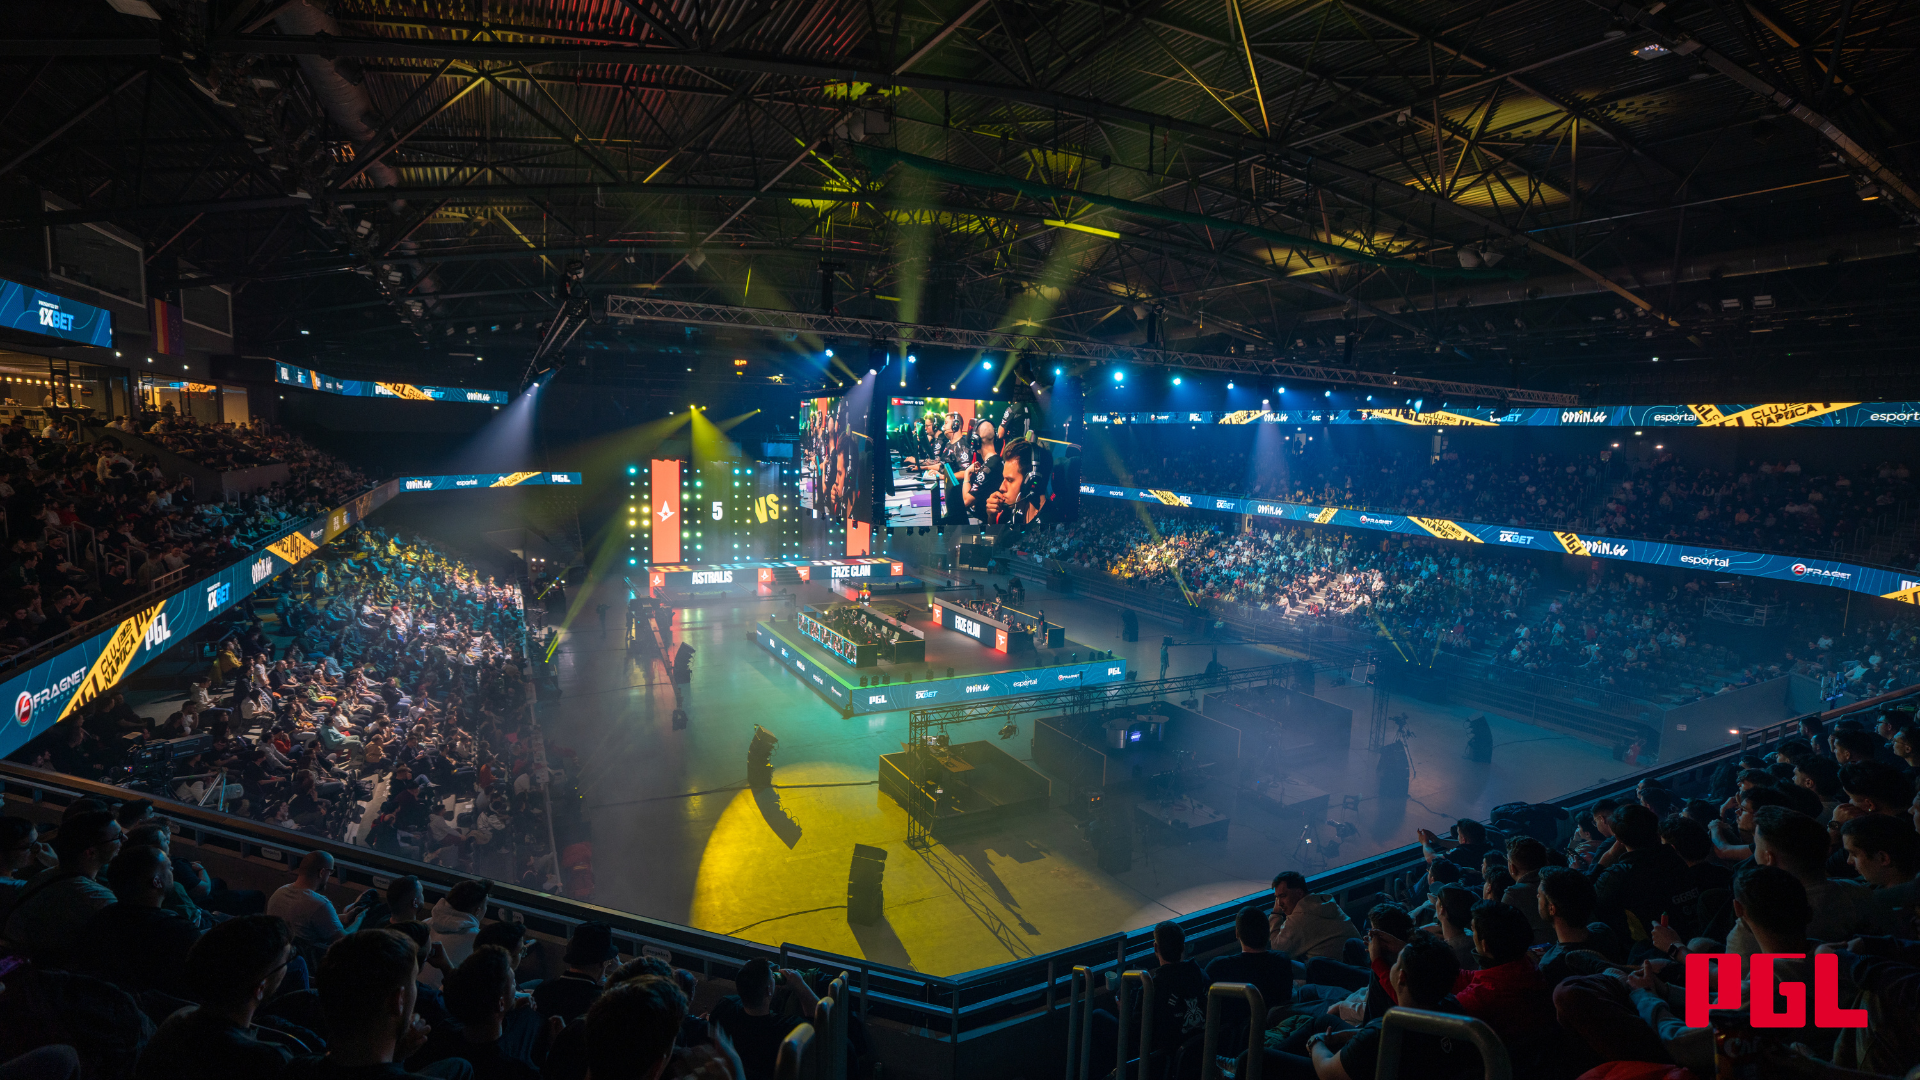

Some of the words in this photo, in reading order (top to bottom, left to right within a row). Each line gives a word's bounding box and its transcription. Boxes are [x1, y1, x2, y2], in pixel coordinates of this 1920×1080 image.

[39, 307, 75, 332] 1XBET
[1654, 412, 1697, 422] esportal
[1751, 403, 1788, 420] CLUJ
[1870, 411, 1920, 423] esport
[551, 474, 571, 483] PGL
[712, 501, 723, 521] 5
[754, 493, 780, 524] VS
[1499, 533, 1534, 545] 1XBET
[1681, 555, 1729, 568] esportal
[691, 571, 733, 584] ASTRALIS
[831, 566, 850, 578] FAZE
[851, 565, 870, 577] CLAN
[208, 582, 230, 612] 1XBET
[145, 612, 171, 651] PGL
[954, 614, 967, 633] FAZE
[967, 619, 980, 639] CLAN
[100, 636, 121, 676] CLUJ
[1108, 666, 1122, 676] PGL
[33, 665, 87, 710] FRAGNET
[1013, 678, 1038, 688] esportal
[868, 695, 888, 705] PGL
[915, 690, 939, 700] 1XBET
[1672, 886, 1700, 905] GGBET
